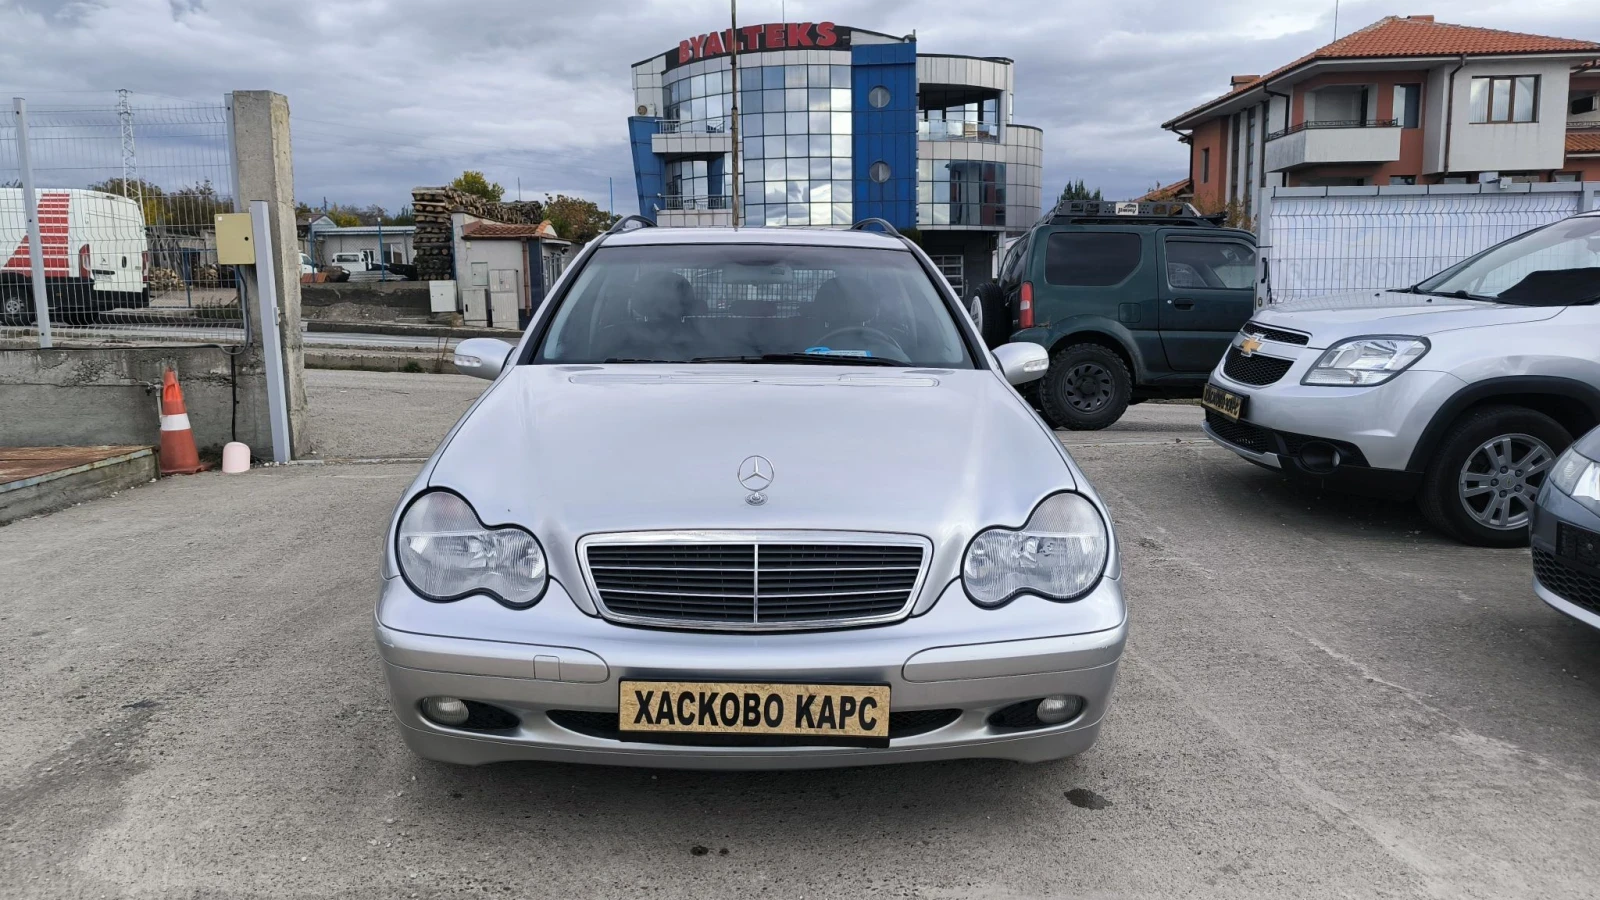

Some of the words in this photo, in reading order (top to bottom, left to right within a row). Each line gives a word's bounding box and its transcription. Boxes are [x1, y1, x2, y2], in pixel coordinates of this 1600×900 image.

[679, 21, 837, 64] BYALTEKS
[634, 690, 784, 728] ХАСКОВО
[795, 694, 878, 731] КАРС
